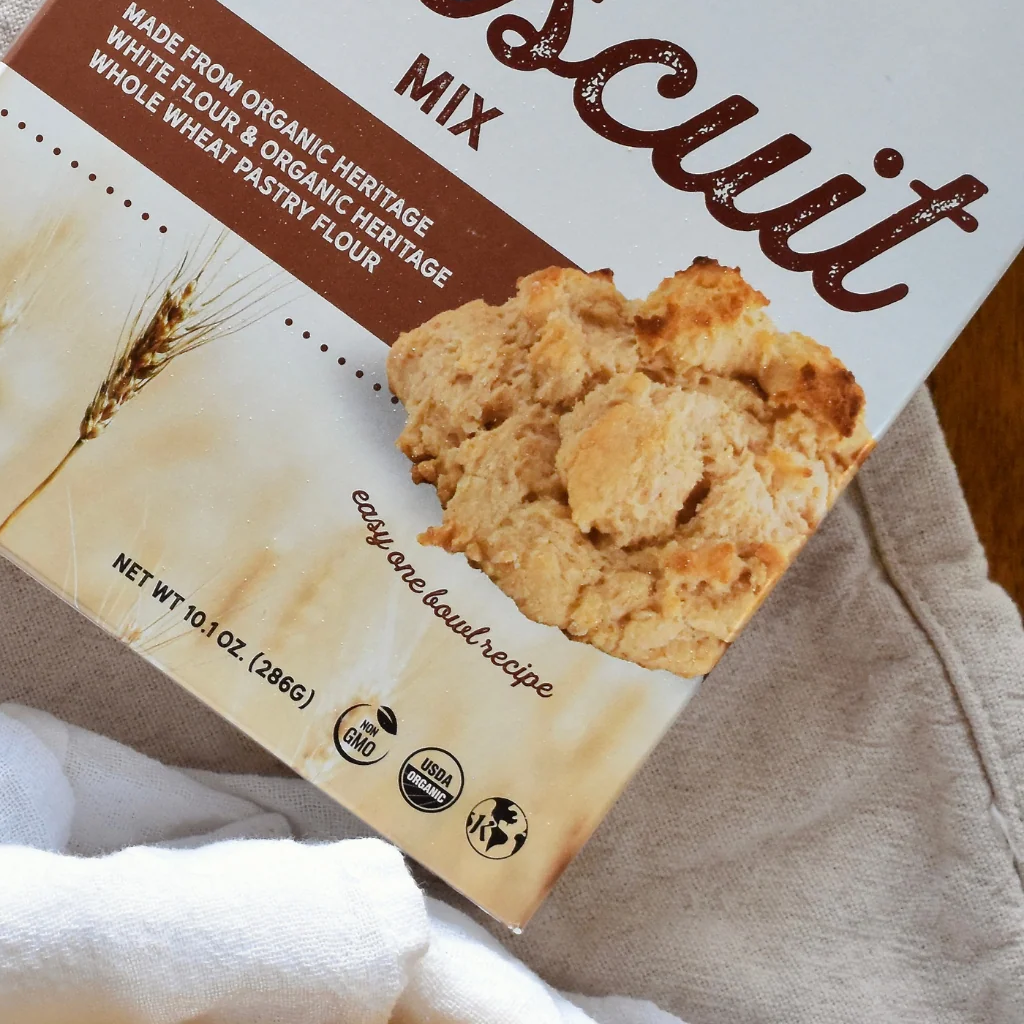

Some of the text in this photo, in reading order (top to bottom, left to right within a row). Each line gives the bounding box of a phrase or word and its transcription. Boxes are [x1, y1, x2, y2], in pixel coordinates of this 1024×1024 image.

[88, 50, 381, 274] WHOLE WHEAT PASTRY FLOUR
[106, 25, 453, 289] WHITE FLOUR & ORGANIC HERITAGE
[122, 2, 434, 237] MADE FROM ORGANIC HERITAGE
[393, 53, 504, 151] MIX
[112, 553, 316, 709] NET WT 10.1 OZ. (286G)
[352, 489, 553, 698] easy one bowl recipe
[342, 727, 377, 757] GMO
[360, 718, 379, 738] NON
[406, 770, 447, 804] ORGANIC
[420, 757, 453, 787] USDA
